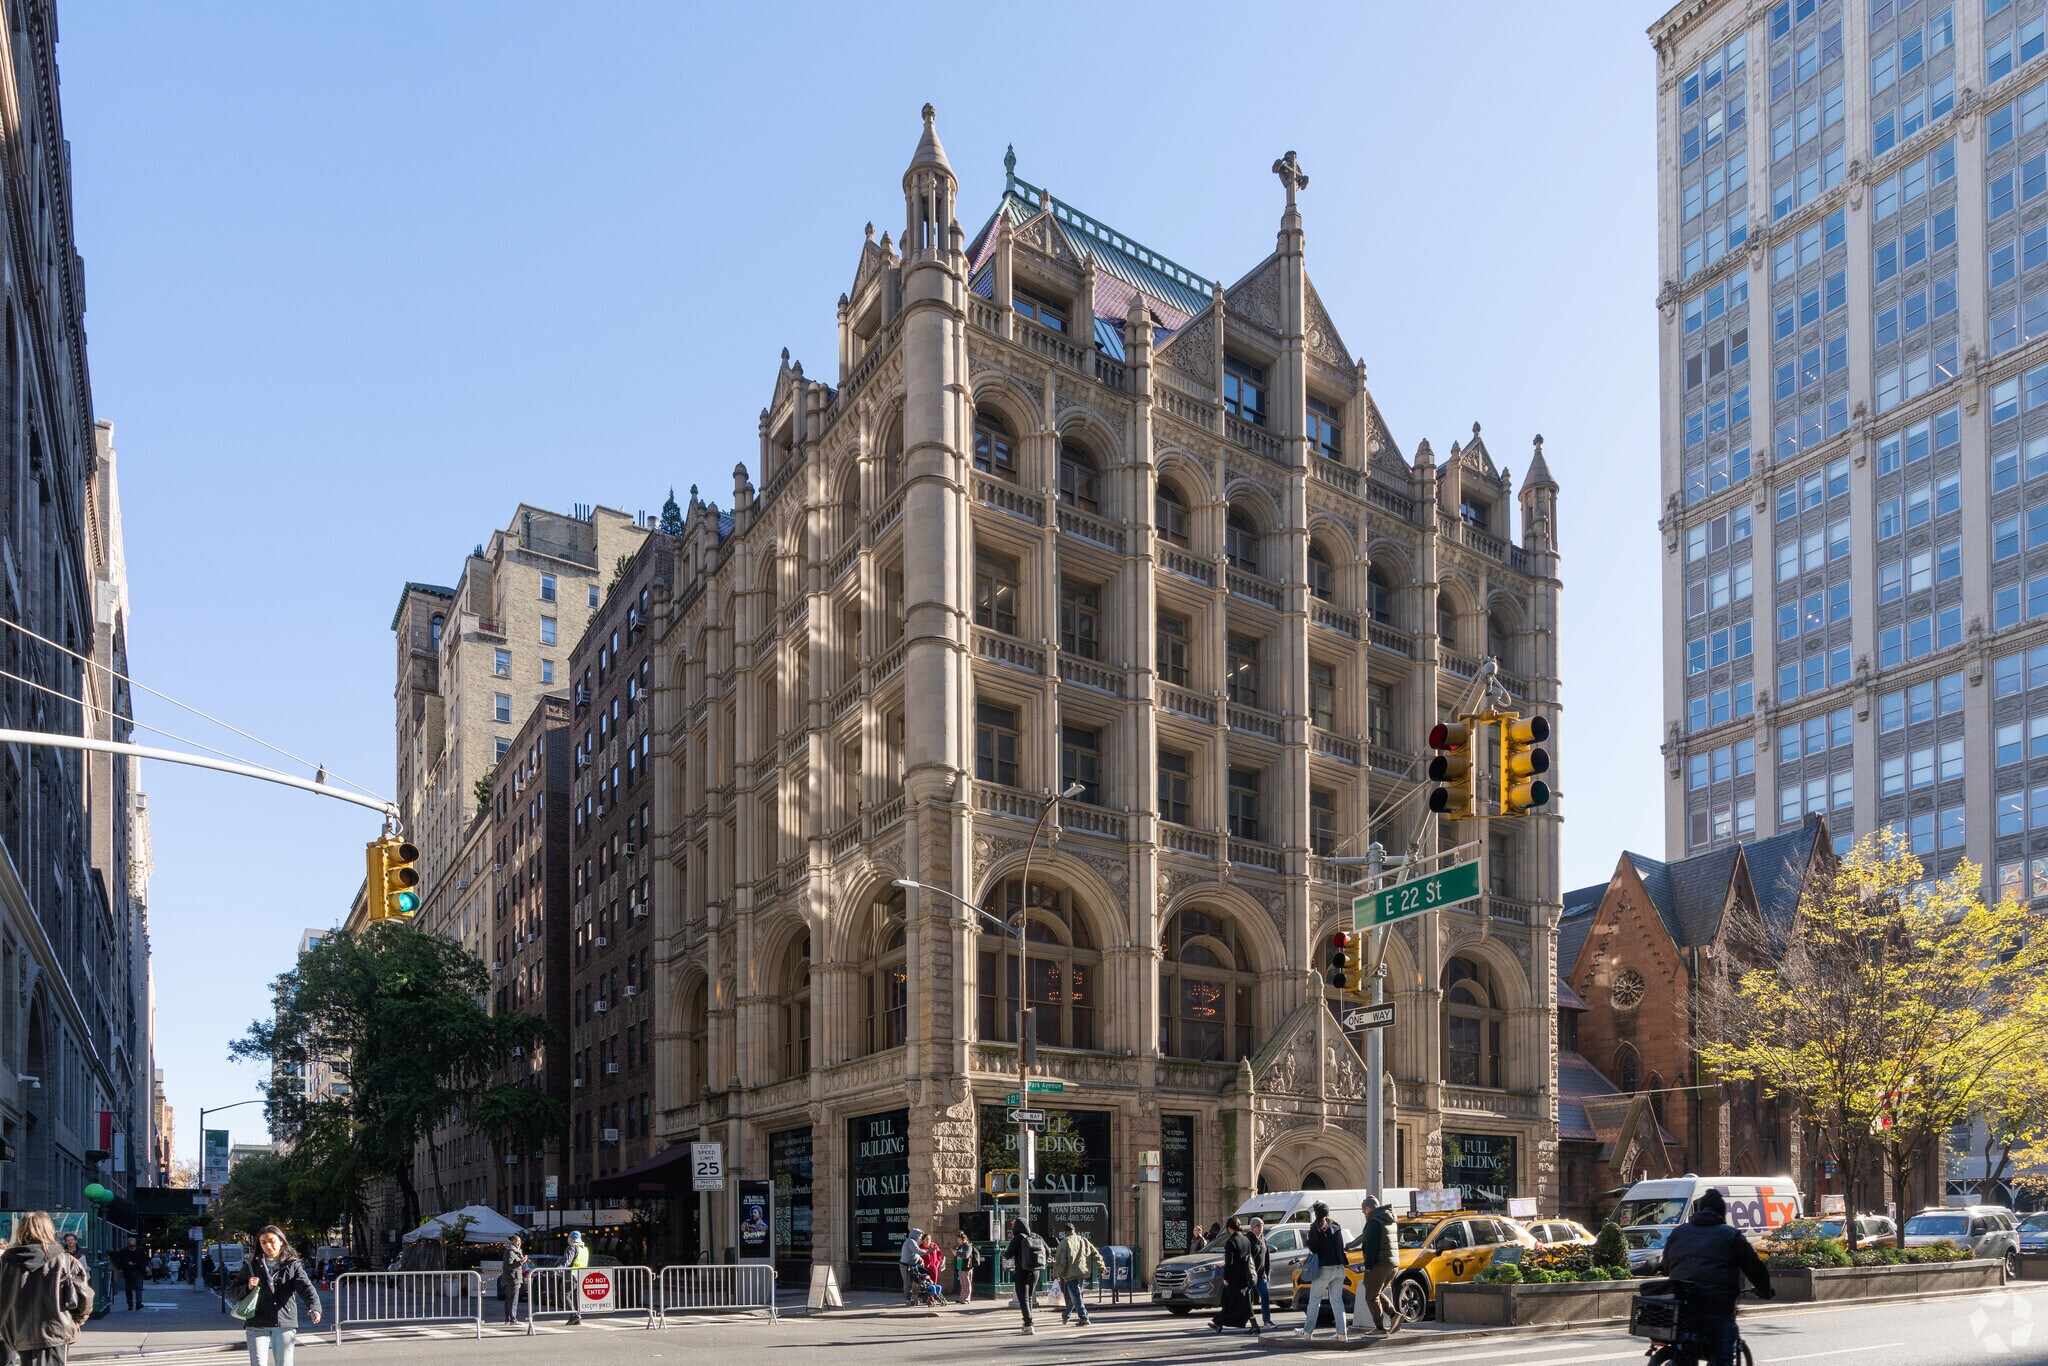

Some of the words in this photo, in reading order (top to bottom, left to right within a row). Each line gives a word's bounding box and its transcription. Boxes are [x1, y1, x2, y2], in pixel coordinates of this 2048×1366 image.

[1385, 894, 1395, 916] E
[1400, 886, 1420, 912] 22
[1426, 879, 1442, 904] St
[1348, 1014, 1365, 1026] ONE
[1372, 1009, 1391, 1022] WAY
[870, 1119, 894, 1138] FULL
[861, 1136, 905, 1158] BUILDING
[1464, 1140, 1491, 1154] FULL
[697, 1162, 720, 1175] 25
[1453, 1154, 1502, 1169] BUILDING
[856, 1176, 878, 1197] FOR
[880, 1173, 909, 1195] SALE
[1044, 1173, 1096, 1193] SALE
[1051, 1206, 1068, 1214] RYAN
[1070, 1206, 1099, 1214] SERHANT
[1055, 1214, 1095, 1222] 646.480.7665
